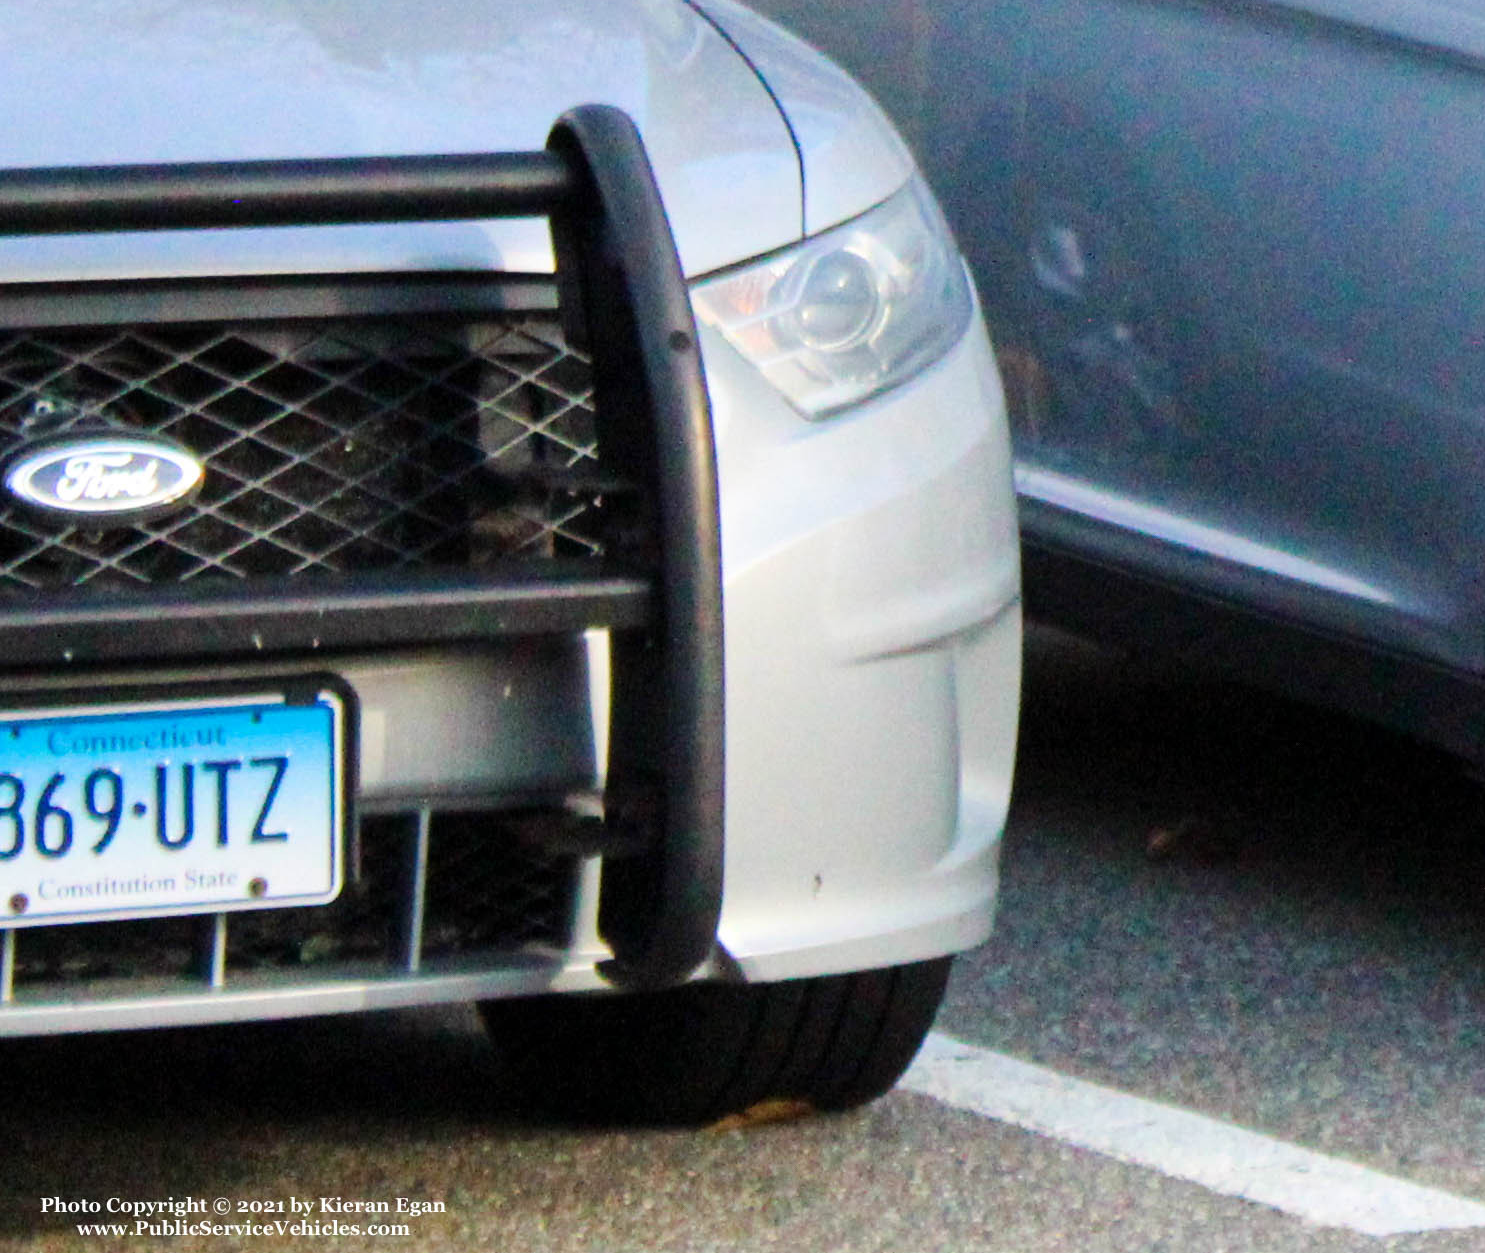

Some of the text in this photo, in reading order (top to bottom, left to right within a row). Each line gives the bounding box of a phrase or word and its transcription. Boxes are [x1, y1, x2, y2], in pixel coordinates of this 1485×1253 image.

[56, 452, 158, 502] Ford
[46, 724, 227, 756] Connecticut
[37, 868, 239, 901] Constitution State
